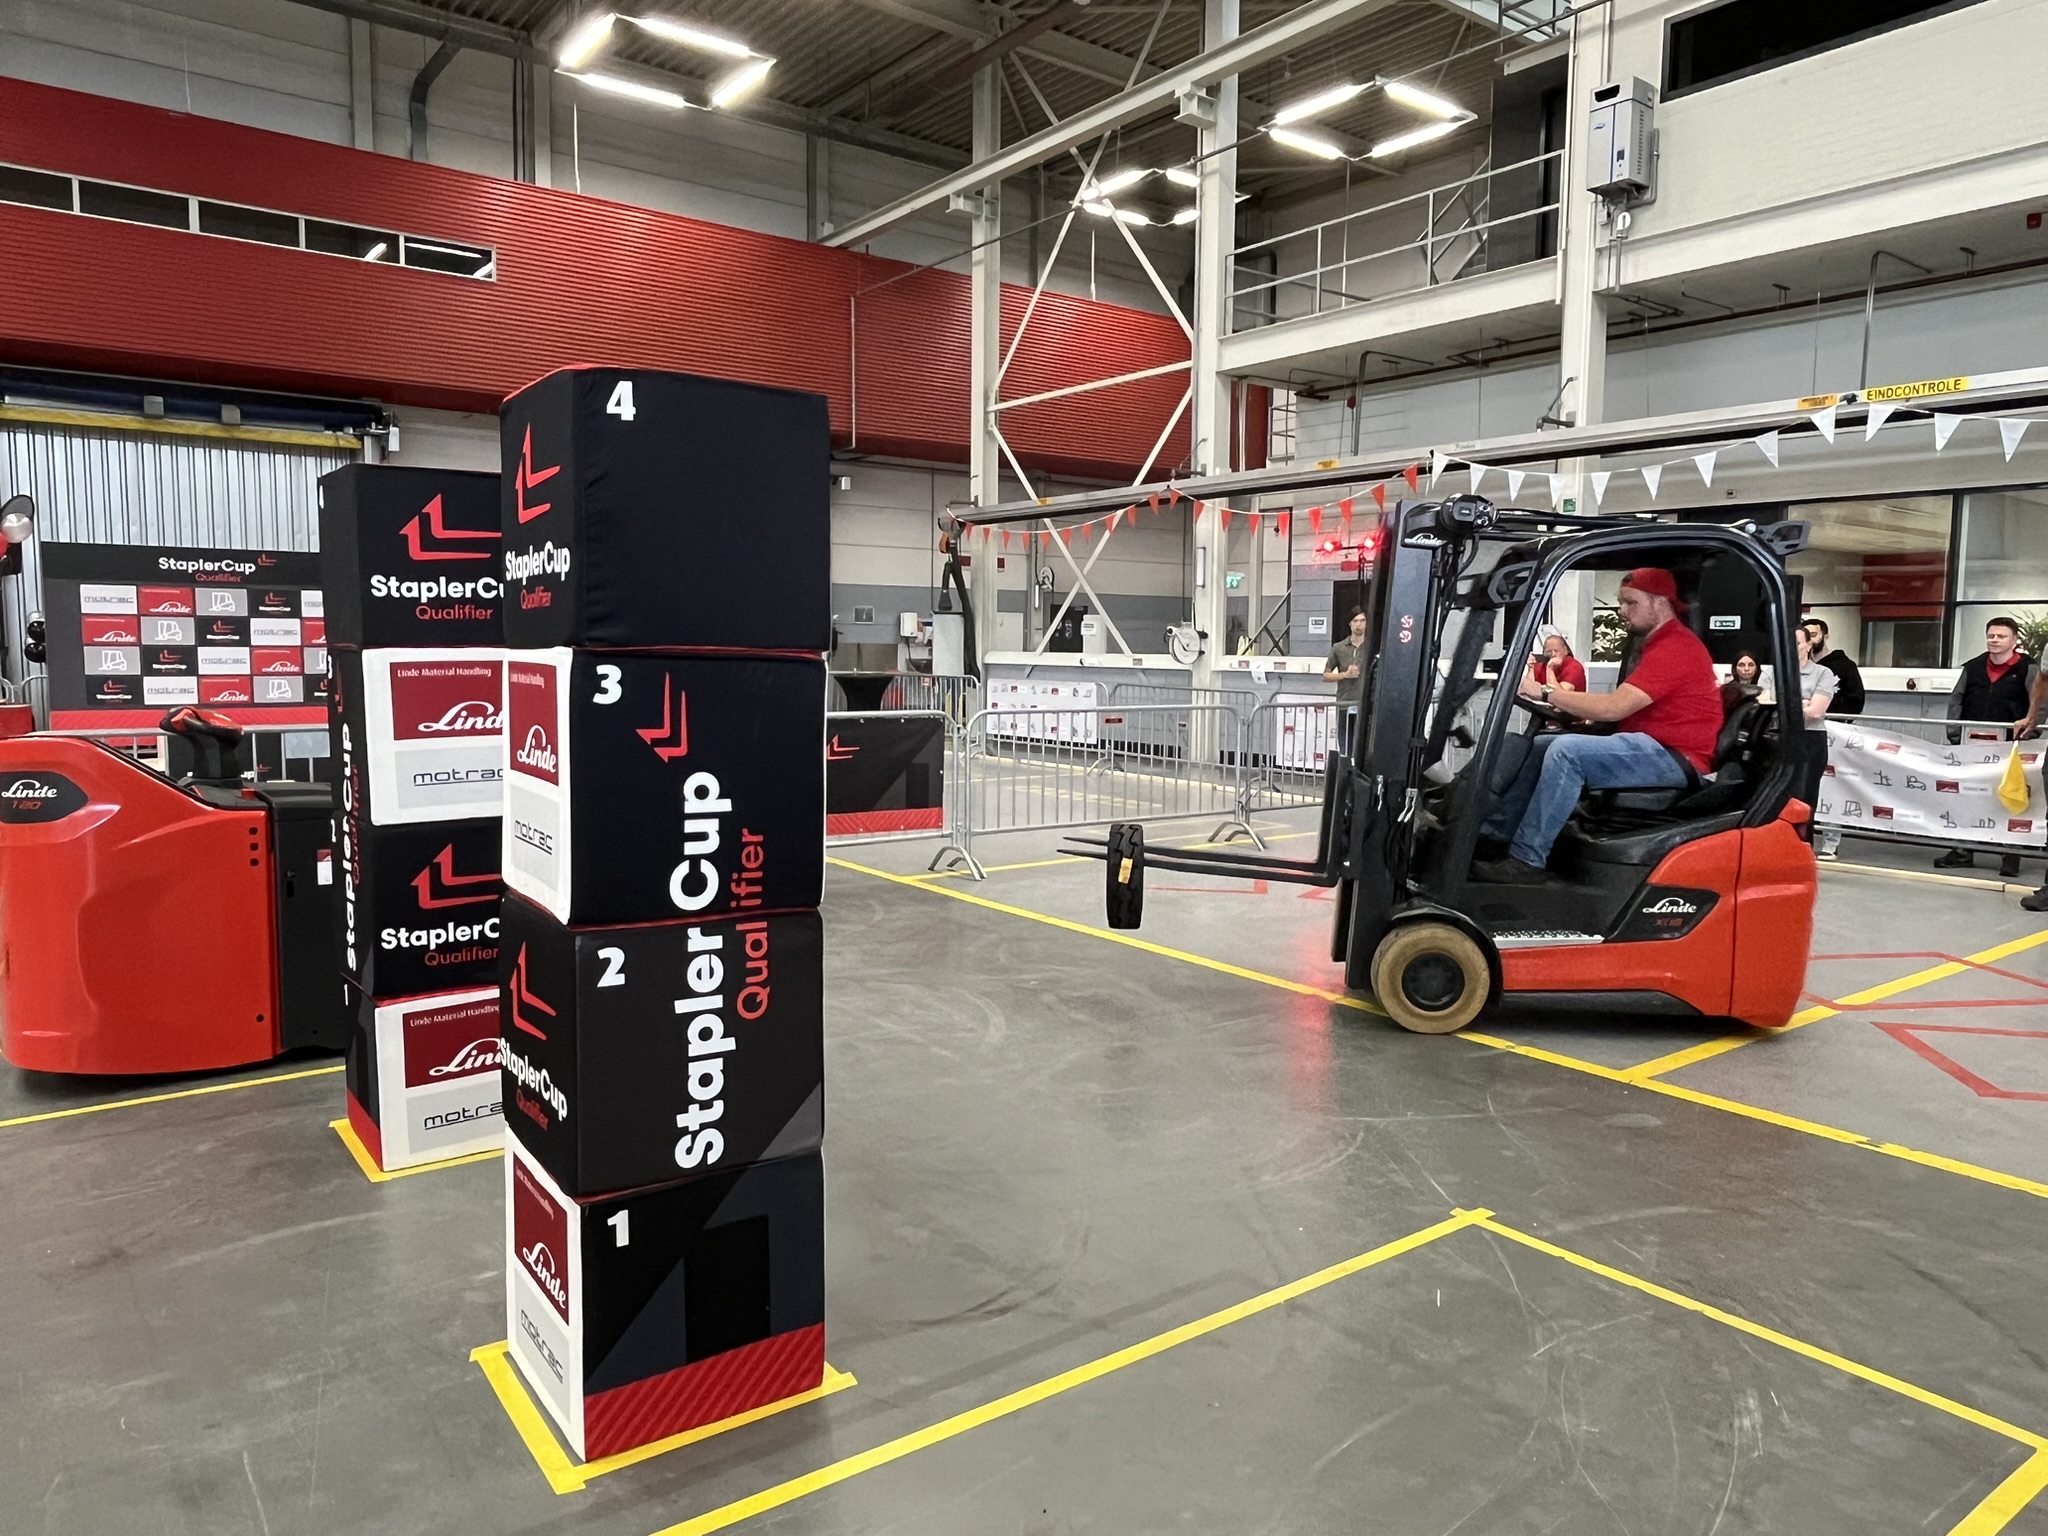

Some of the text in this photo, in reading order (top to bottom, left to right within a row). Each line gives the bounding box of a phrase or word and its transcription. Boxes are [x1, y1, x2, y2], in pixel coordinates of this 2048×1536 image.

[606, 381, 636, 421] 4
[1867, 379, 1962, 401] EINDCONTROLE
[158, 556, 256, 575] StaplerCup
[505, 541, 571, 585] StaplerCup
[370, 574, 504, 603] StaplerC
[415, 604, 494, 620] Qualifier
[421, 667, 455, 677] Material
[456, 667, 492, 677] Handling
[593, 665, 623, 705] 3
[417, 700, 503, 732] Lind
[517, 724, 557, 773] Linde
[1, 779, 58, 798] Linde
[515, 820, 553, 851] motrac
[1642, 897, 1698, 914] Linde
[424, 946, 500, 966] Qualifier
[597, 947, 627, 988] 2
[433, 1010, 467, 1023] Material
[500, 1037, 568, 1122] StaplerCup
[607, 1209, 630, 1248] 1
[522, 1242, 567, 1309] Linde
[520, 1309, 563, 1381] motrac
